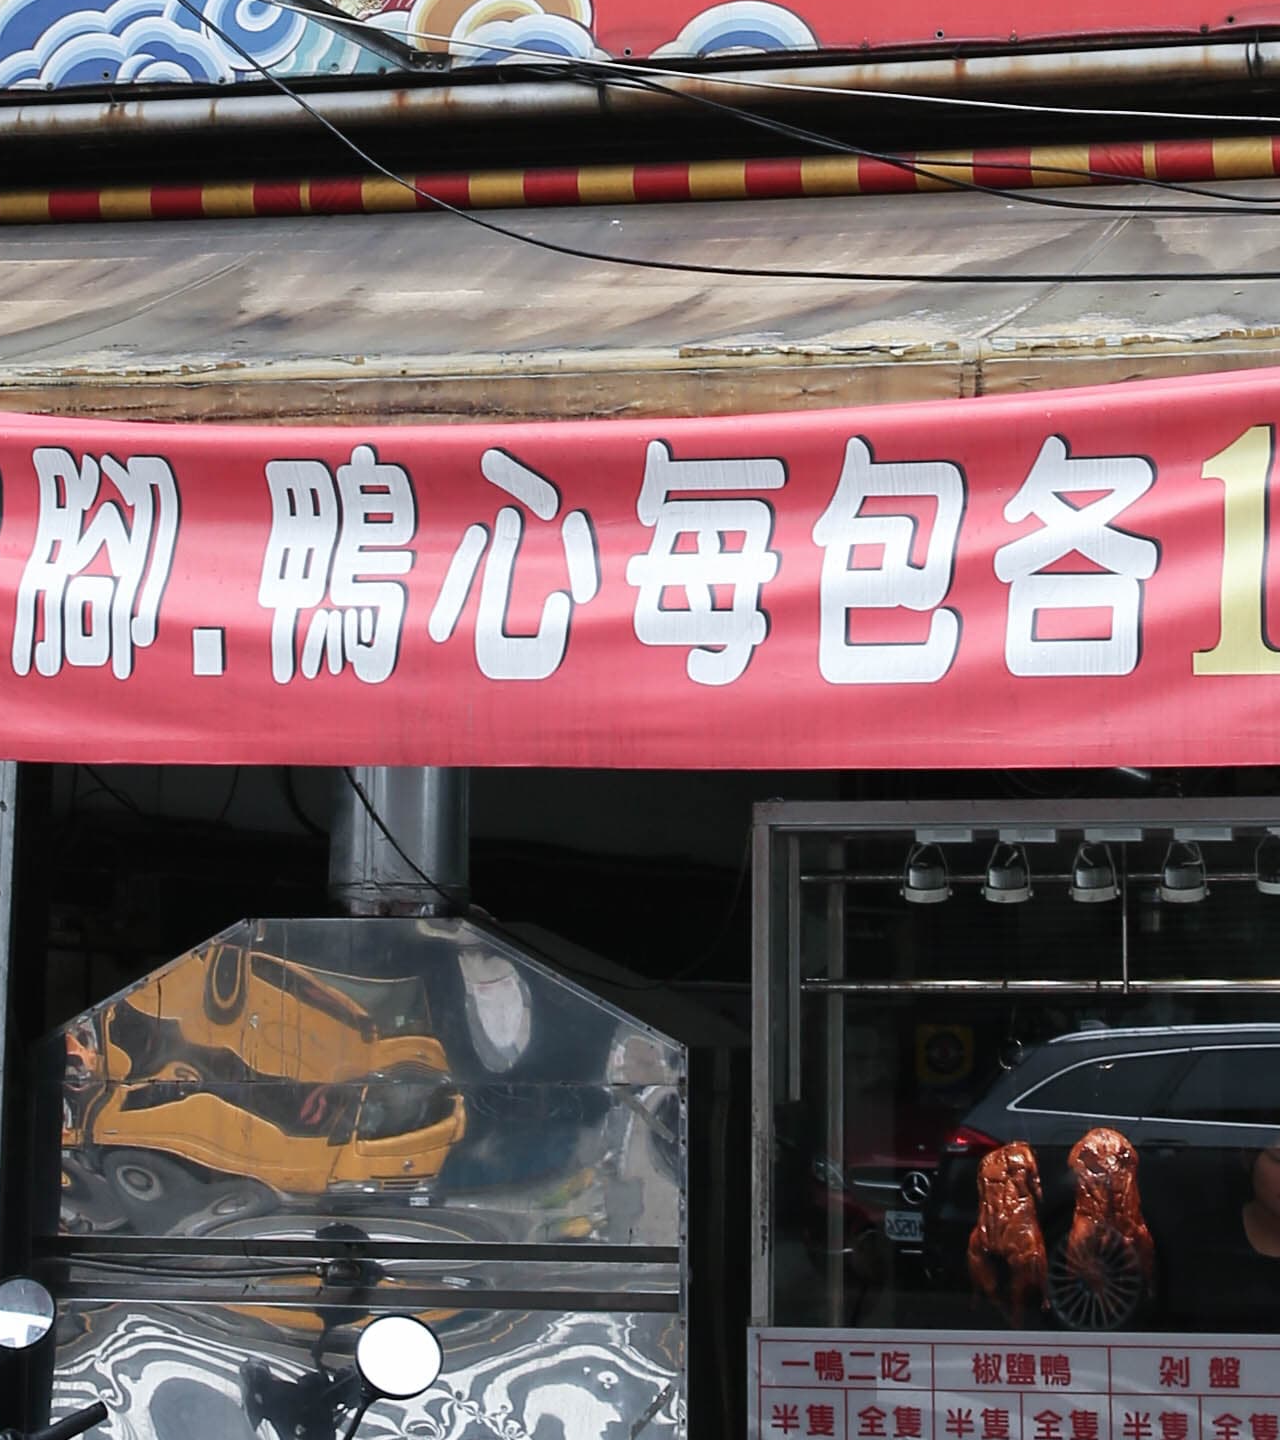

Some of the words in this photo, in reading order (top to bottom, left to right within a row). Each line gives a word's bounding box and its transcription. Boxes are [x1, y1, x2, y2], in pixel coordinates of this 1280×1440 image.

[782, 1350, 912, 1383] 一鴨二吃
[972, 1353, 1073, 1387] 椒鹽鴨
[771, 1404, 835, 1438] 半隻
[857, 1406, 923, 1439] 全隻
[945, 1408, 1010, 1440] 半隻
